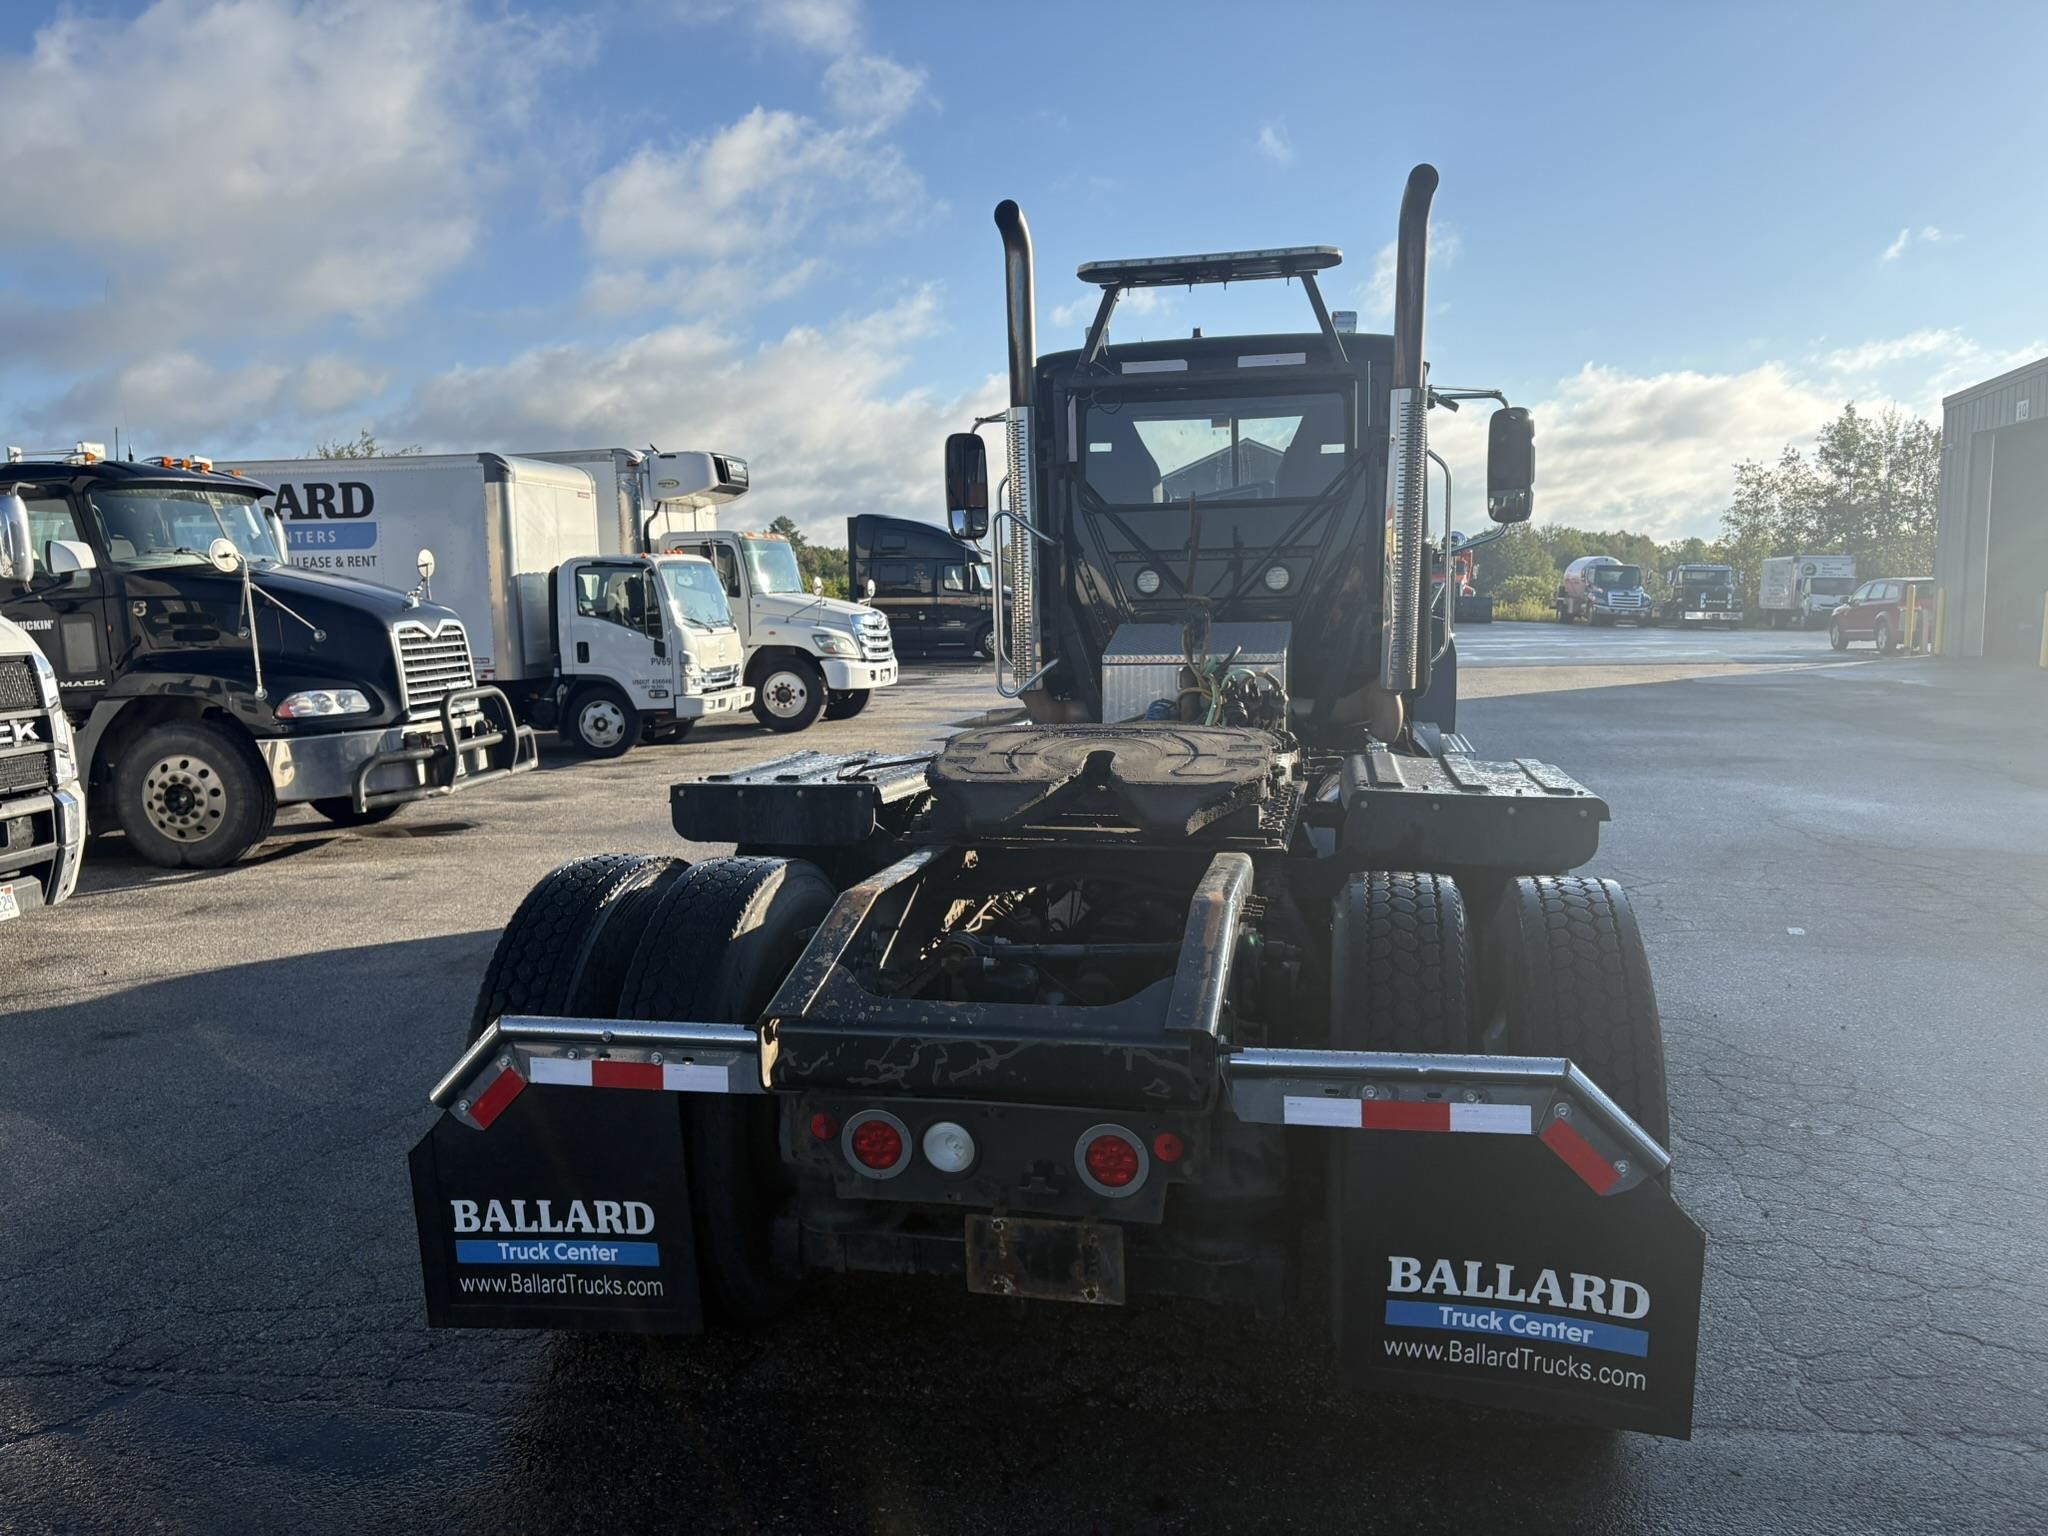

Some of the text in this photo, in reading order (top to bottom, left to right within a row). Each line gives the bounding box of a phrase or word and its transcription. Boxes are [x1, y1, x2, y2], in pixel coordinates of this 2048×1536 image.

[335, 557, 345, 568] &
[347, 555, 377, 568] RENT
[59, 679, 106, 688] MACK
[450, 1199, 656, 1235] BALLARD
[497, 1242, 619, 1262] Truck Center
[459, 1273, 664, 1297] www.BallardTrucks.com
[1386, 1255, 1651, 1320] BALLARD
[1438, 1306, 1594, 1344] Truck Center
[1383, 1339, 1647, 1391] www.BallardTrucks.com
